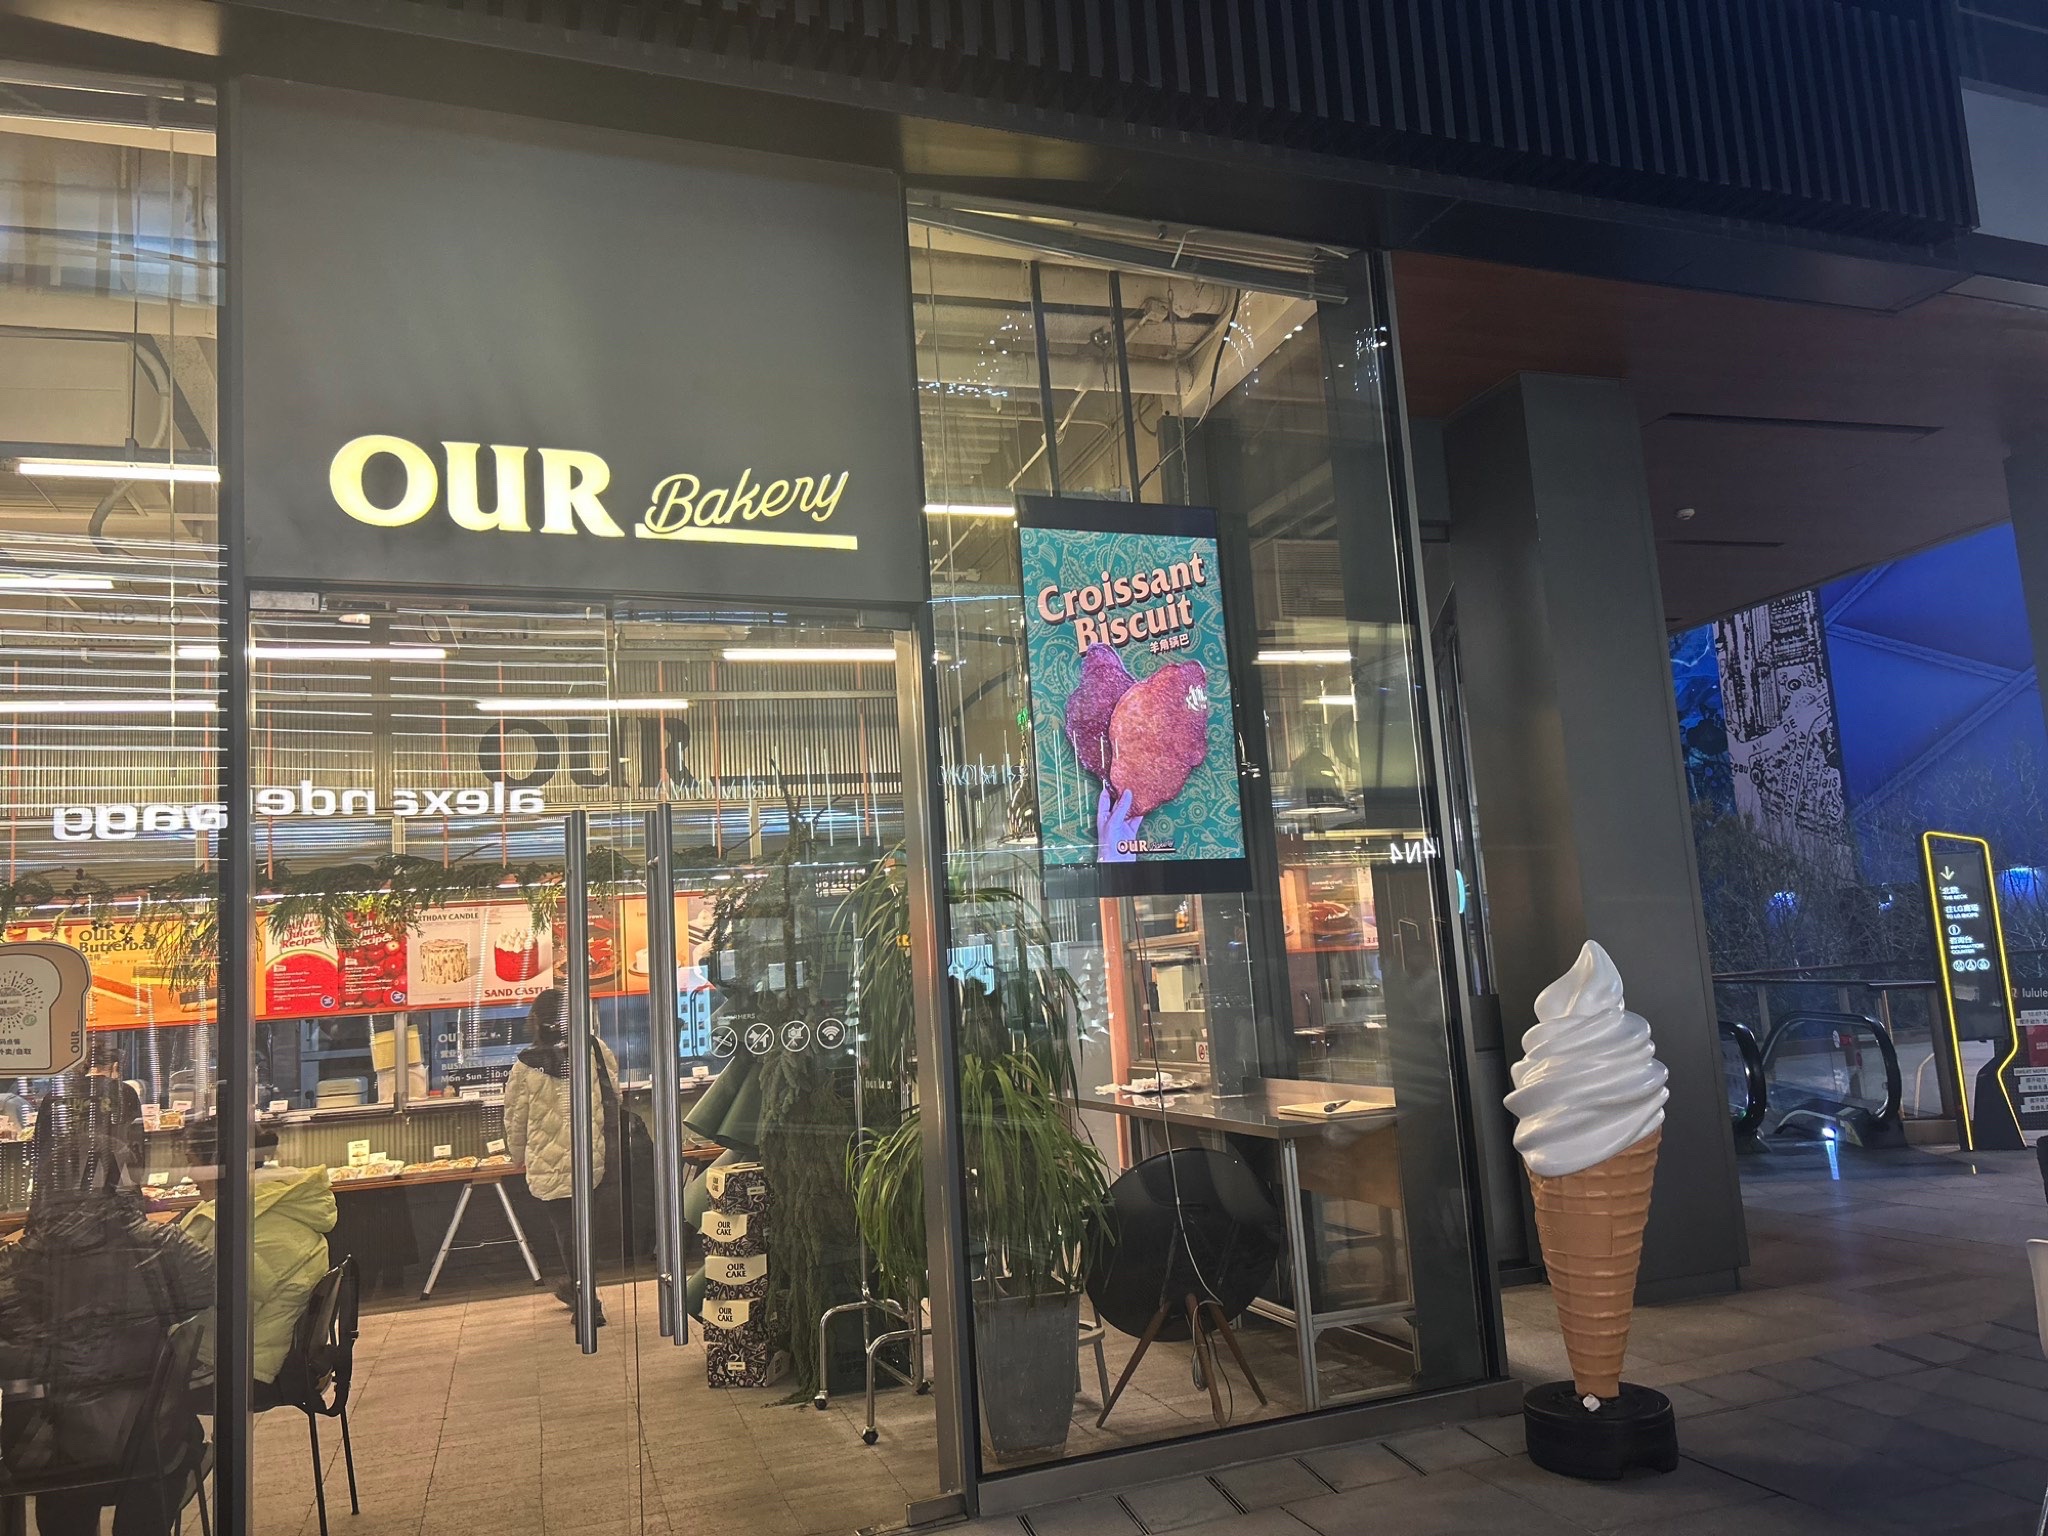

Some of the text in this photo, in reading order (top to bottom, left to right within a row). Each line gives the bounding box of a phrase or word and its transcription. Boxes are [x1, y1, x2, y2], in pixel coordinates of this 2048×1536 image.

[329, 435, 849, 537] OUR Bakery
[1038, 553, 1205, 623] Croissant
[1074, 594, 1193, 654] Biscuit
[1117, 840, 1148, 853] OUR
[448, 912, 479, 920] CANDLE
[79, 930, 117, 941] OUR
[281, 936, 325, 949] Recipes
[484, 988, 513, 998] SAND
[70, 1030, 80, 1054] OUR
[717, 1220, 731, 1229] OUR
[716, 1228, 732, 1236] CAKE
[727, 1263, 745, 1271] OUR
[725, 1270, 747, 1278] CAKE
[718, 1306, 732, 1315] OUR
[717, 1313, 734, 1322] CAKE
